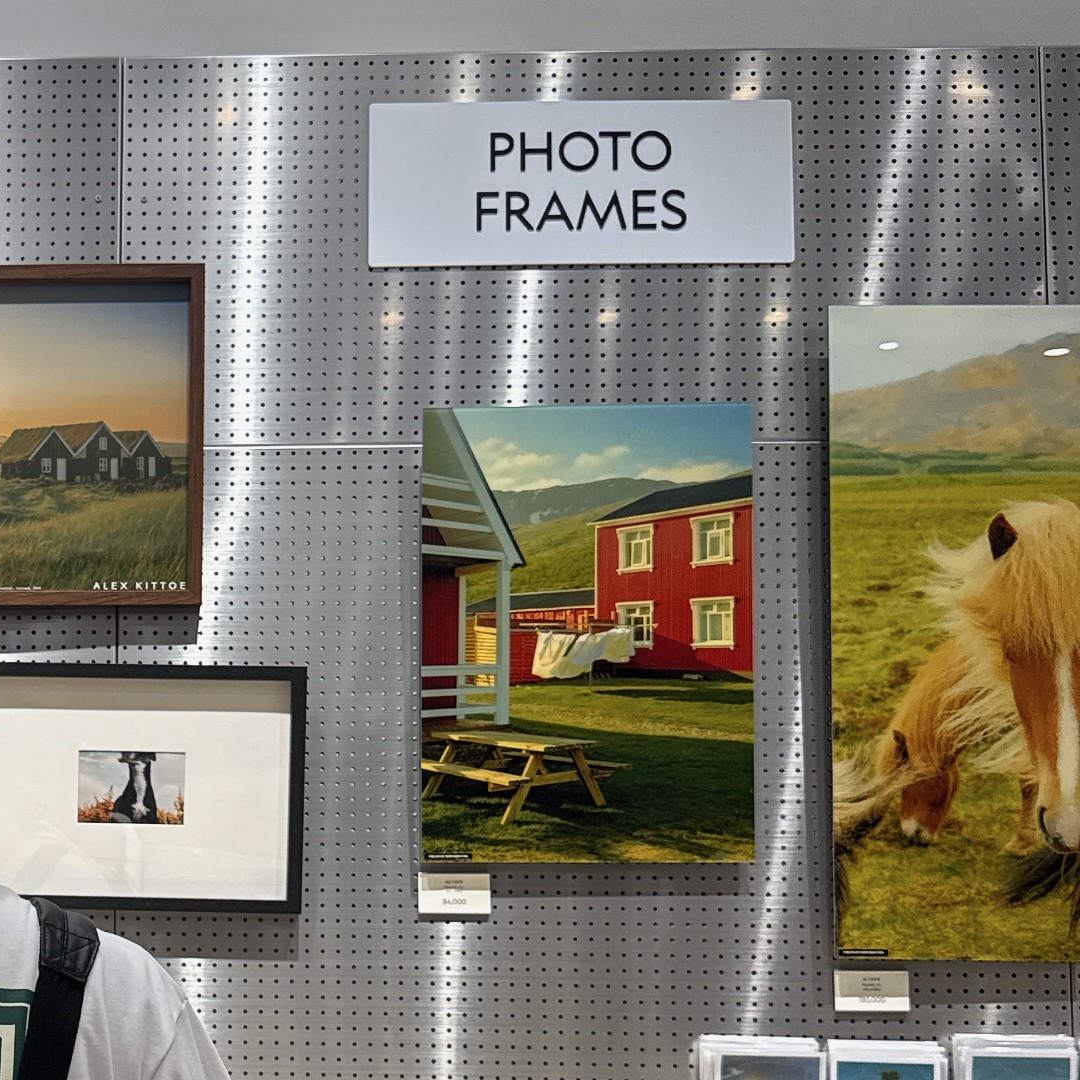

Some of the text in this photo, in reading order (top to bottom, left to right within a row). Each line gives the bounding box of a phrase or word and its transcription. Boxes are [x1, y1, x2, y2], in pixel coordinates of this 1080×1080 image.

[489, 129, 673, 173] PHOTO
[476, 189, 688, 232] FRAMES
[92, 581, 187, 591] ALEX KITTOE
